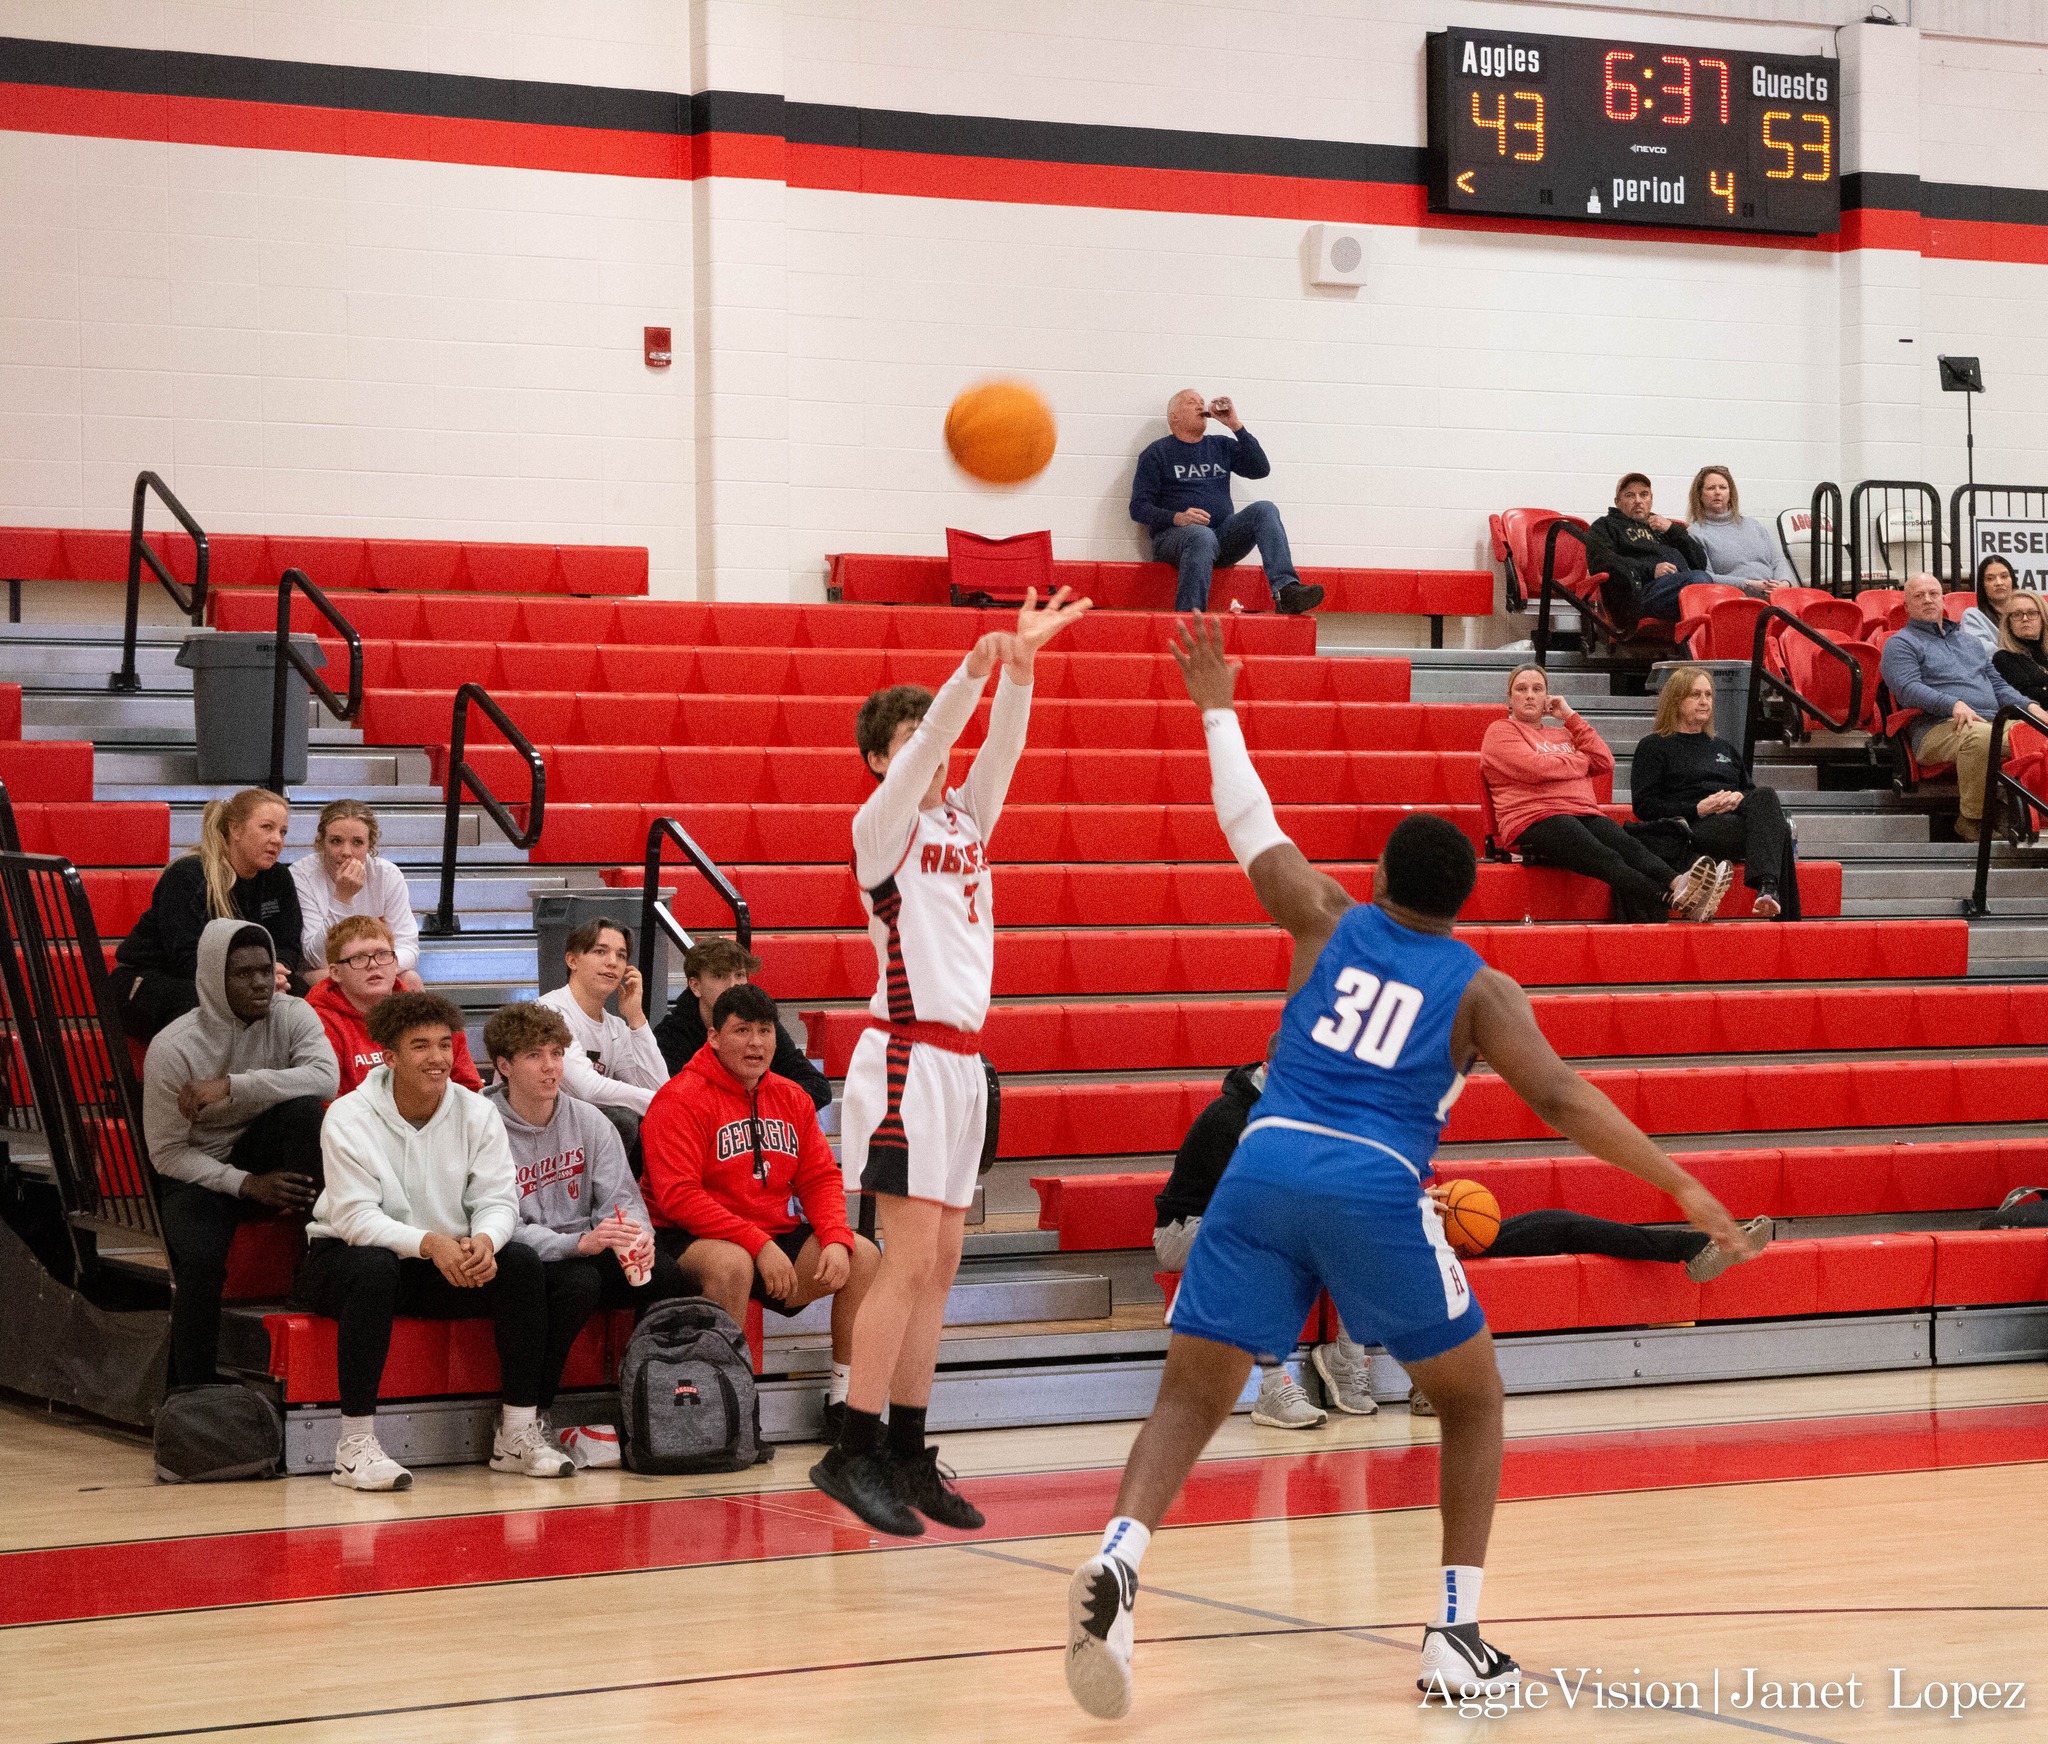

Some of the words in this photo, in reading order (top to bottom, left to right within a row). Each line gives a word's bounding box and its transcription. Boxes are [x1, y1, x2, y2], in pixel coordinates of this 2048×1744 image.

[1461, 41, 1540, 78] Aggies
[1603, 50, 1729, 125] 6:37
[1752, 65, 1829, 102] Guests
[1471, 90, 1545, 162] 43
[1762, 111, 1831, 181] 53
[1612, 175, 1685, 208] period
[1709, 170, 1735, 214] 4
[1173, 463, 1228, 479] PAPA
[1981, 531, 2048, 553] RESE
[2012, 569, 2048, 591] EAT
[963, 882, 979, 924] 7
[1310, 966, 1425, 1069] 30
[717, 1117, 799, 1161] GEORGIA
[1449, 1264, 1466, 1297] H
